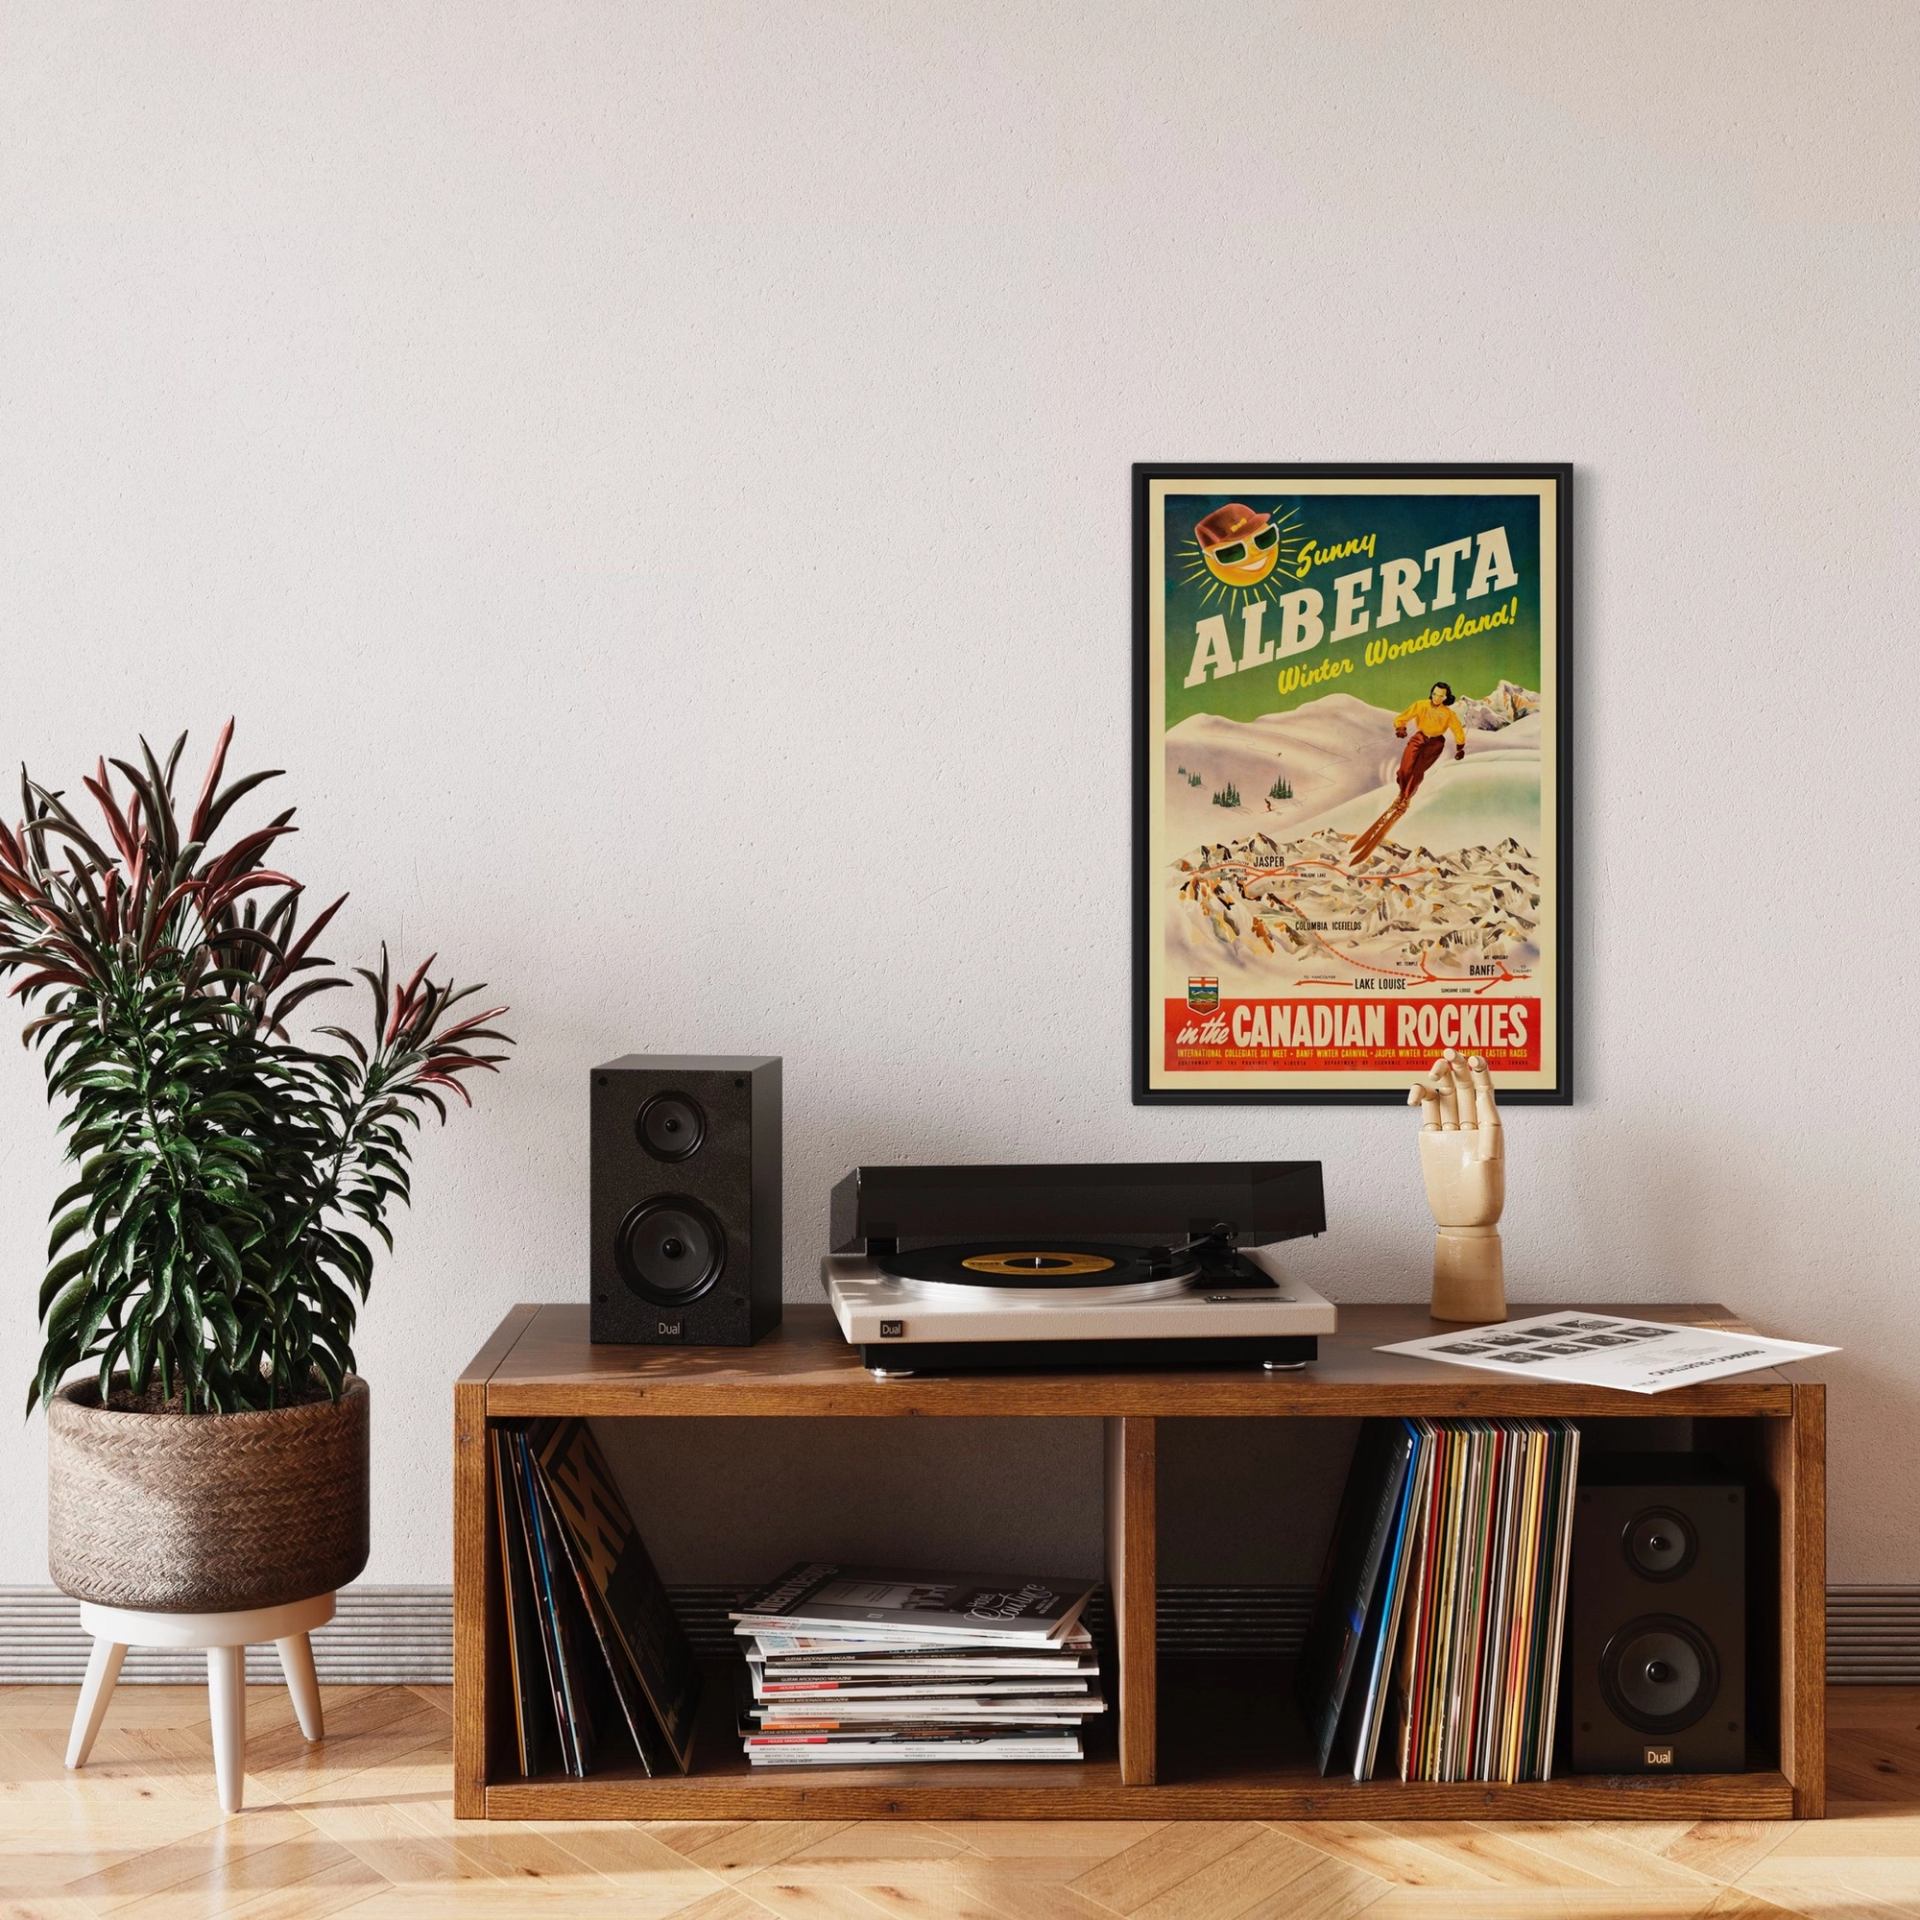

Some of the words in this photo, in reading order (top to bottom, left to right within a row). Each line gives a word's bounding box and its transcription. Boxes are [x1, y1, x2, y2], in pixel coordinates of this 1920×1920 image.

[1296, 533, 1377, 579] Sunny
[1183, 526, 1519, 689] ALBERTA
[1277, 658, 1354, 695] Winter
[1364, 597, 1519, 668] Wonderland!
[1253, 856, 1285, 868] JASPER
[1295, 921, 1328, 931] COLUMBIA
[1331, 921, 1362, 931] ICEFIELDS
[1469, 965, 1495, 976] BANFF
[1354, 978, 1375, 990] LAKE
[1378, 978, 1407, 990] LOUISE
[1176, 1020, 1200, 1045] in
[1199, 1011, 1230, 1045] the
[1231, 1004, 1386, 1048] CANADIAN
[1397, 1003, 1529, 1048] ROCKIES
[1177, 1048, 1222, 1058] INTERNATIONAL
[1224, 1048, 1258, 1058] COLLEGIATE
[1272, 1048, 1287, 1058] MEET
[1295, 1048, 1314, 1058] BANFF
[1316, 1048, 1339, 1058] WINTER
[1341, 1048, 1369, 1058] CARNIVAL
[1375, 1048, 1396, 1058] JASPER
[1398, 1048, 1421, 1058] WINTER
[1485, 1048, 1507, 1058] EASTER
[1509, 1048, 1528, 1058] RACES
[658, 1322, 681, 1335] Dual
[882, 1324, 902, 1335] Dual
[1647, 1750, 1671, 1764] Dual
